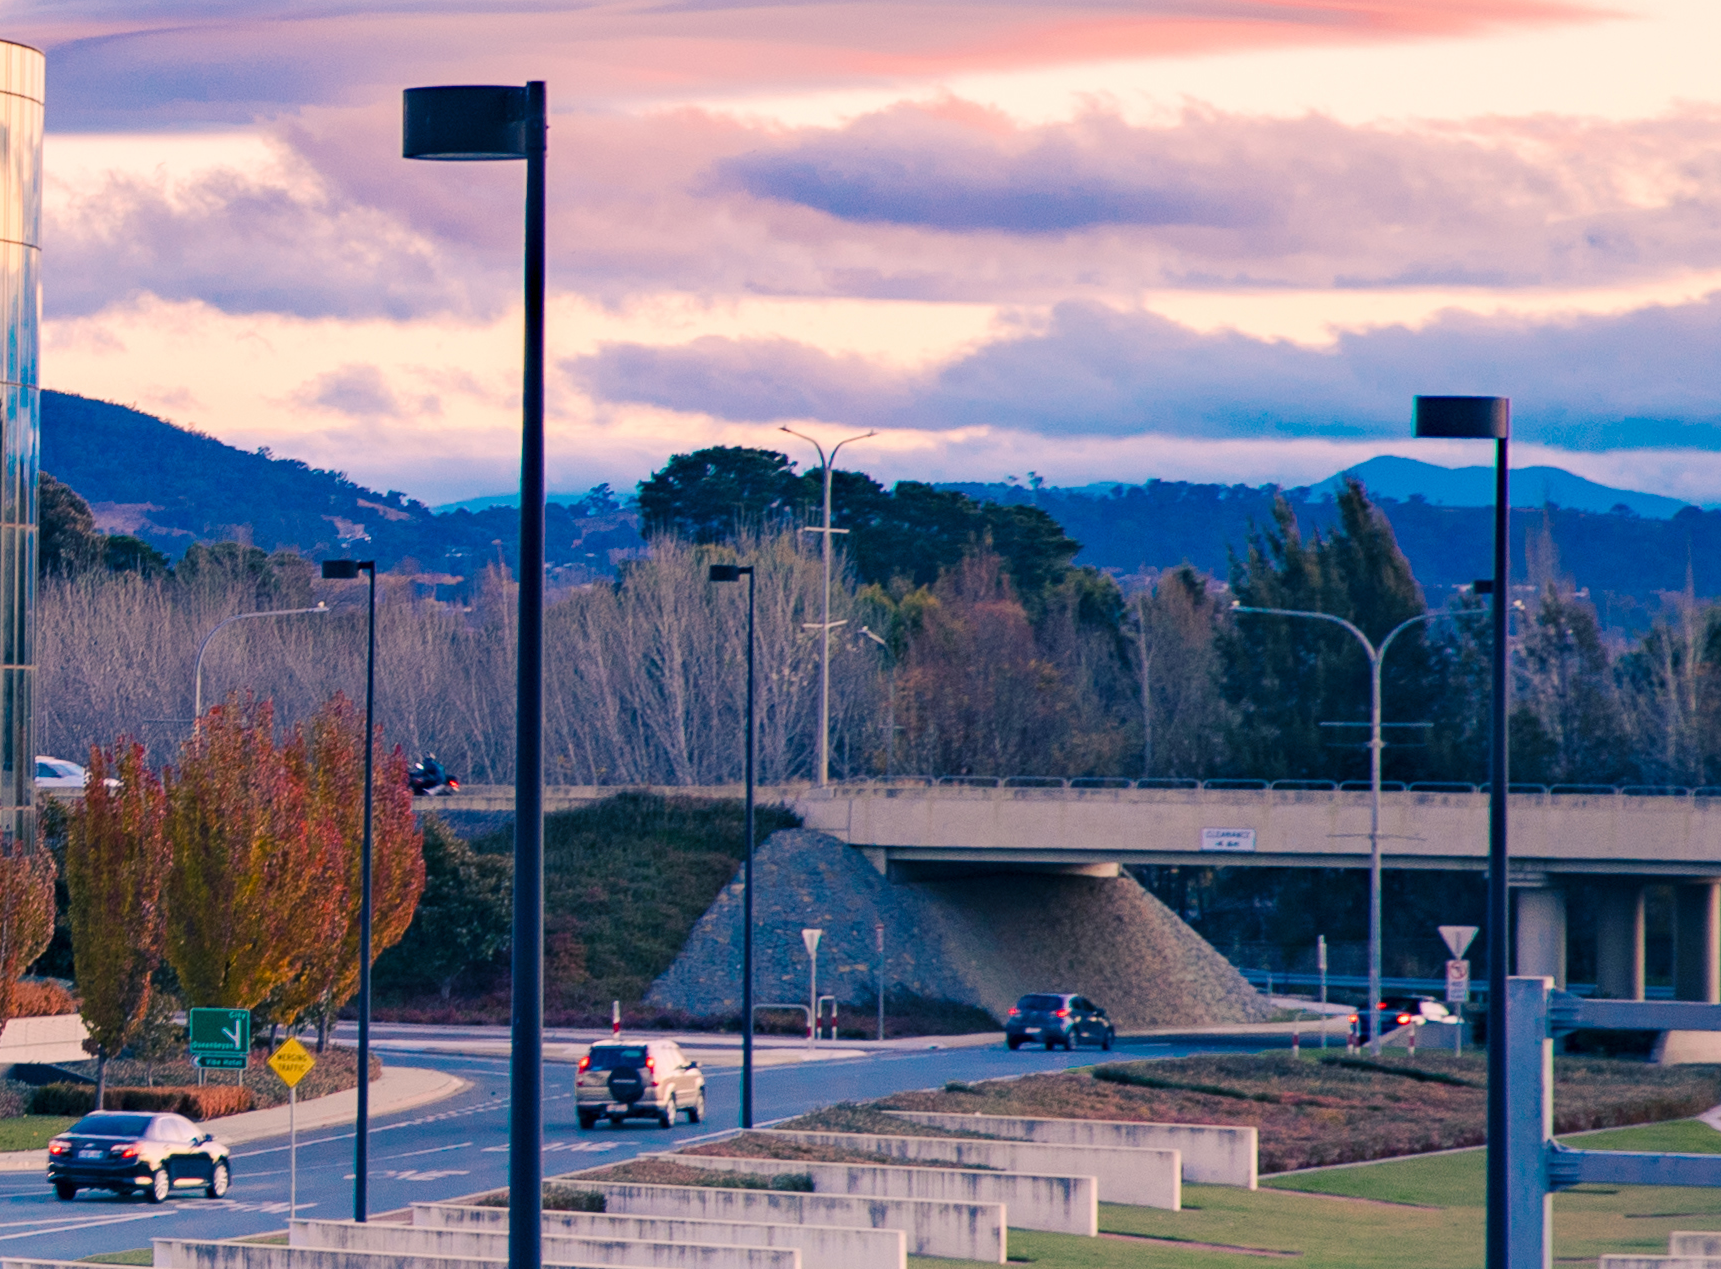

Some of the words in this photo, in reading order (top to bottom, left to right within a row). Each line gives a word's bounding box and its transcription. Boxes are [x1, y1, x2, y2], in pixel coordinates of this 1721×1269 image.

[229, 1011, 246, 1019] City
[277, 1053, 307, 1061] MERGING
[278, 1064, 305, 1072] TRAFFIC
